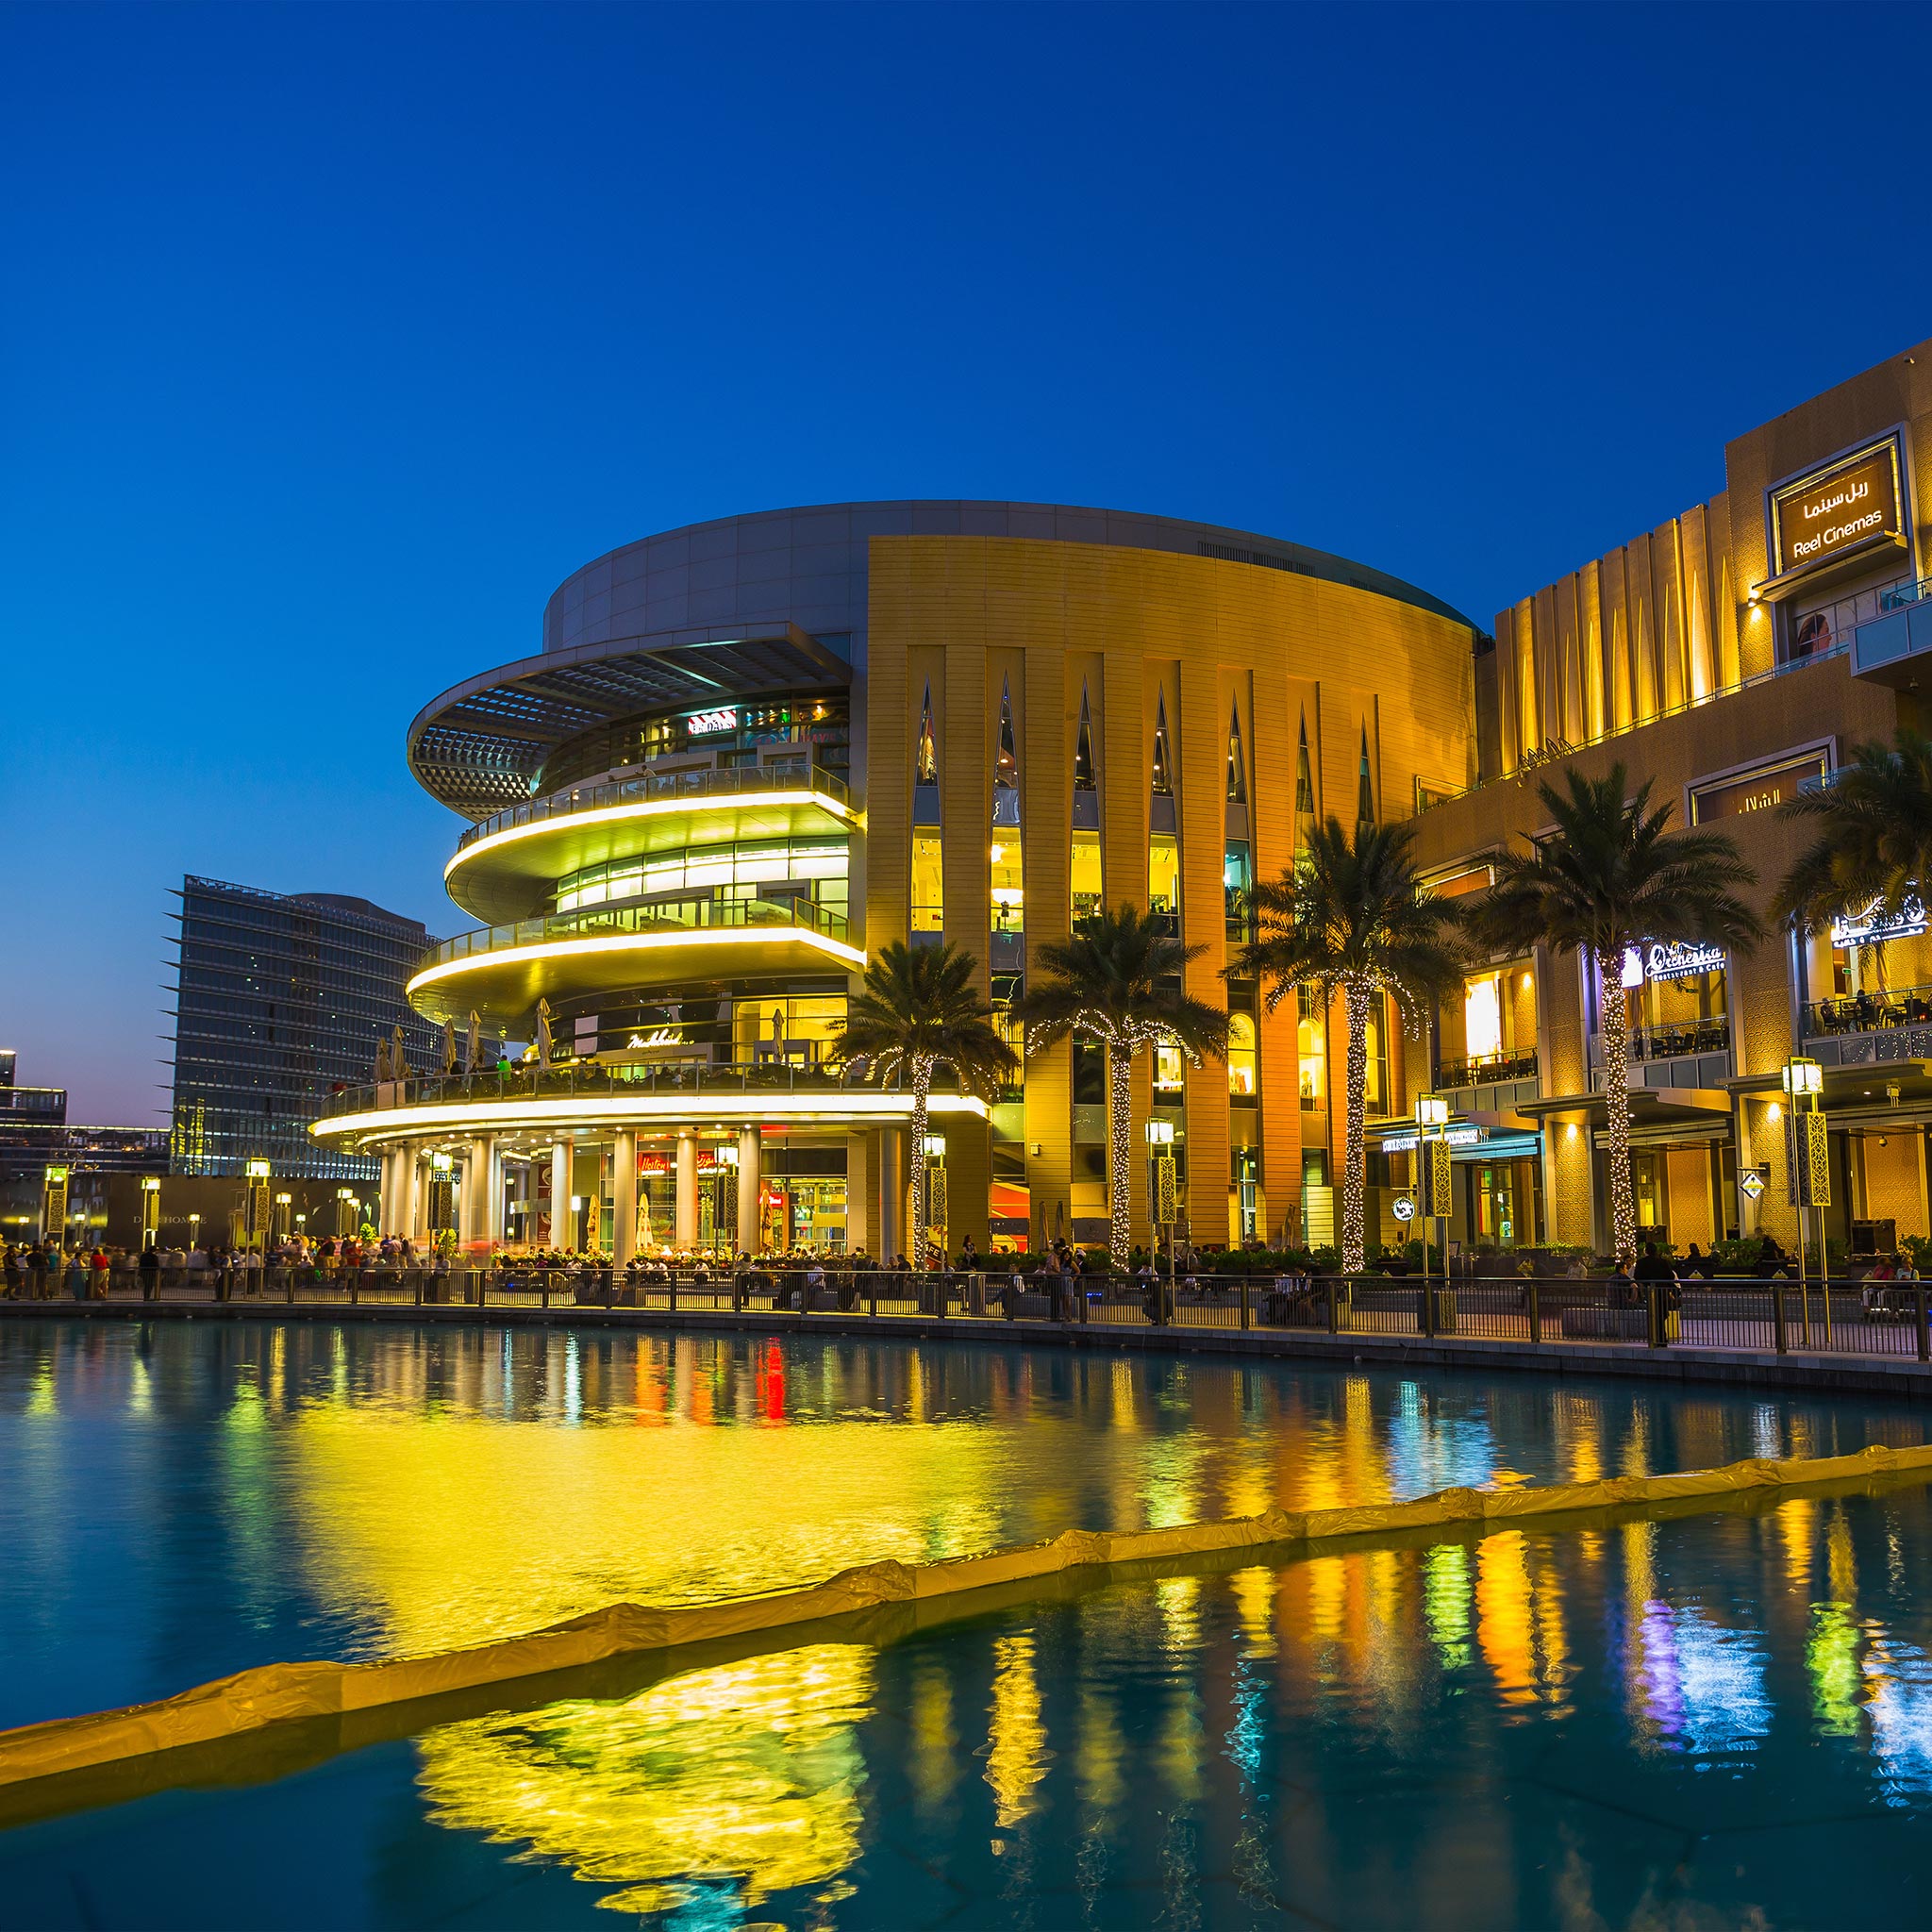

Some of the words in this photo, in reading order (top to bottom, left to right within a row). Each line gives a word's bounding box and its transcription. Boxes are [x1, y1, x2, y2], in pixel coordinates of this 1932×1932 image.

[1845, 482, 1868, 504] ريل
[1804, 492, 1844, 519] سينما
[1793, 533, 1821, 558] Reel
[1823, 509, 1882, 545] Cinemas
[164, 1215, 208, 1224] HOME
